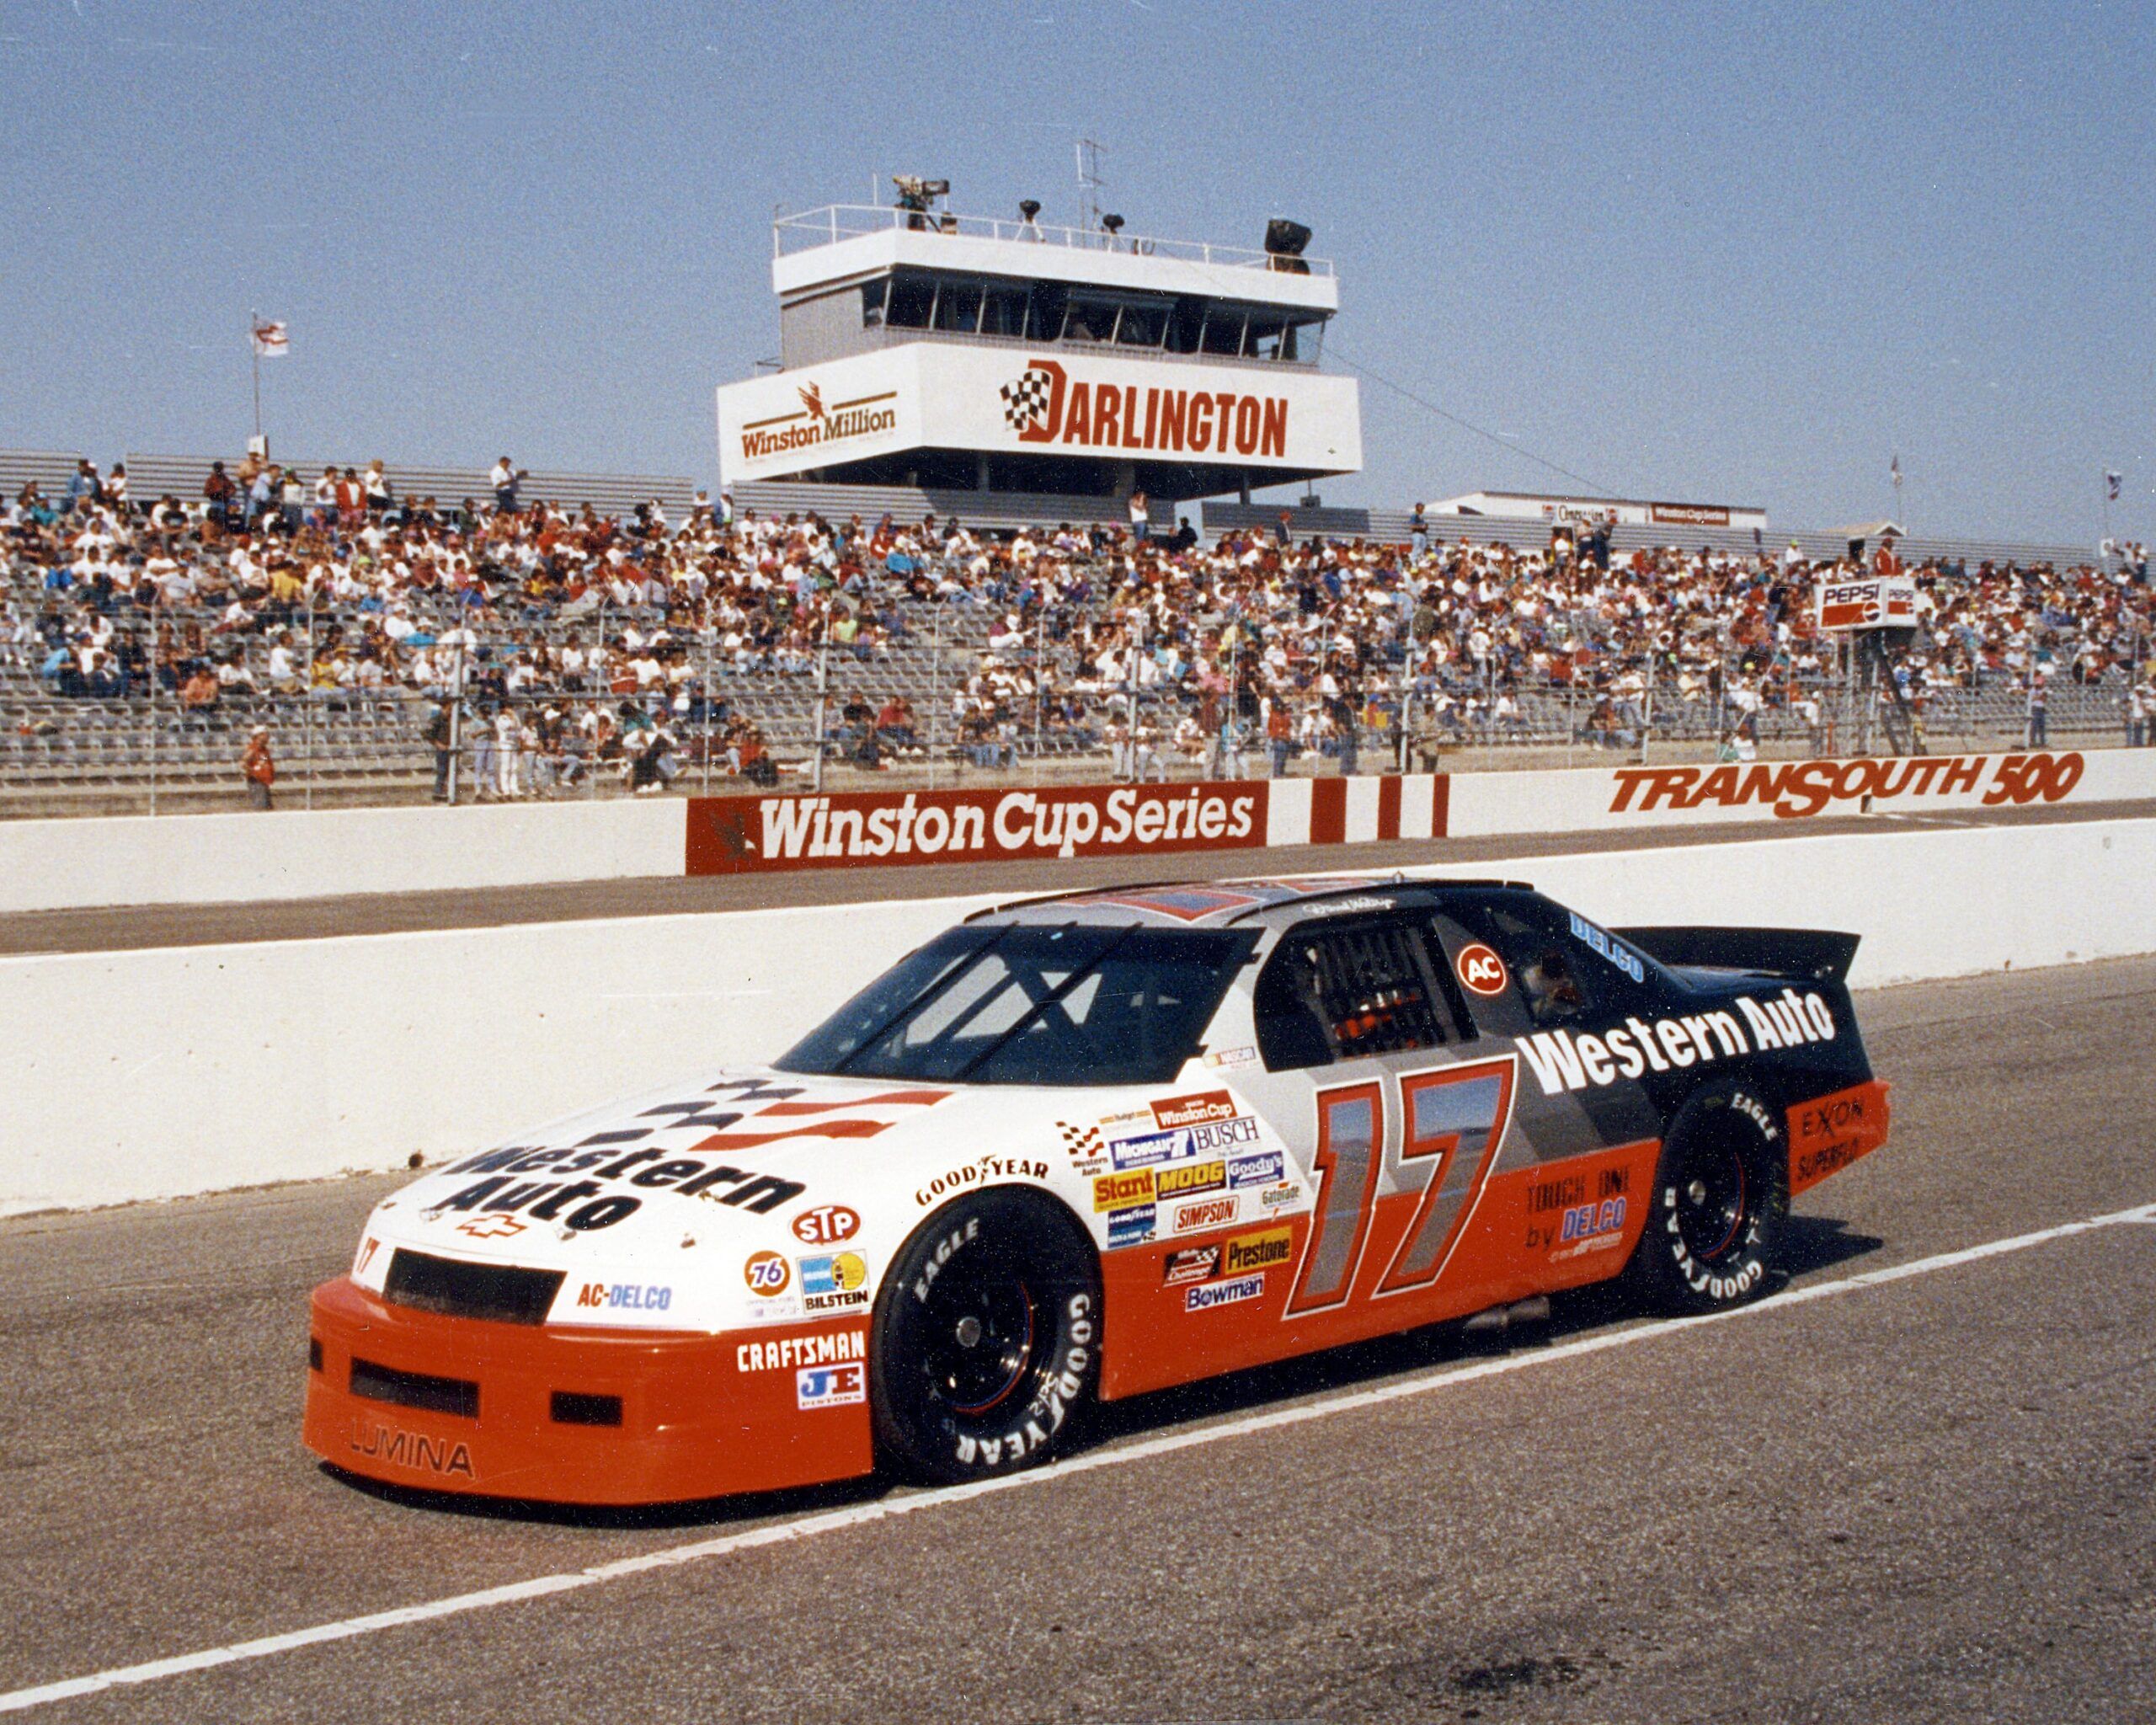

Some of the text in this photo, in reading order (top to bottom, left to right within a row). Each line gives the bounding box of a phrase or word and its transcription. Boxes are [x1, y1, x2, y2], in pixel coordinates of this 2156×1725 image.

[1019, 360, 1289, 457] DARLINGTON
[742, 424, 820, 458] Winston
[823, 409, 896, 441] Million
[1823, 583, 1881, 606] PEPSI
[1982, 752, 2084, 806] 500
[760, 787, 1253, 858] Winston Cup Series
[1569, 911, 1645, 984] DELCO
[1468, 955, 1501, 982] AC
[1515, 987, 1837, 1096] Western Auto
[1158, 1108, 1208, 1126] Winston
[1207, 1102, 1232, 1118] Cup
[1731, 1092, 1779, 1140] EAGLE
[1195, 1119, 1260, 1151] BUSCH
[1072, 1156, 1108, 1168] Western
[1081, 1166, 1102, 1177] Auto
[1158, 1162, 1225, 1193] MOOG
[1229, 1154, 1283, 1178] Goody's
[442, 1145, 806, 1215] Western
[1096, 1168, 1154, 1203] Stant
[1262, 1185, 1300, 1205] Gatorade
[1281, 1052, 1518, 1322] 17
[432, 1176, 643, 1231] Auto
[1177, 1199, 1234, 1228] SIMPSON
[1561, 1195, 1627, 1242] DELCO
[799, 1207, 854, 1242] STP
[915, 1217, 980, 1303] EAGLE
[1228, 1238, 1289, 1269] Prestone
[750, 1258, 784, 1289] 76
[576, 1283, 672, 1311] AC-DELCO
[805, 1291, 869, 1311] BILSTEIN
[1187, 1278, 1263, 1307] Bowman
[737, 1331, 866, 1372] CRAFTSMAN
[801, 1366, 860, 1398] JE
[802, 1393, 862, 1407] PISTONS
[350, 1418, 476, 1480] LUMINA
